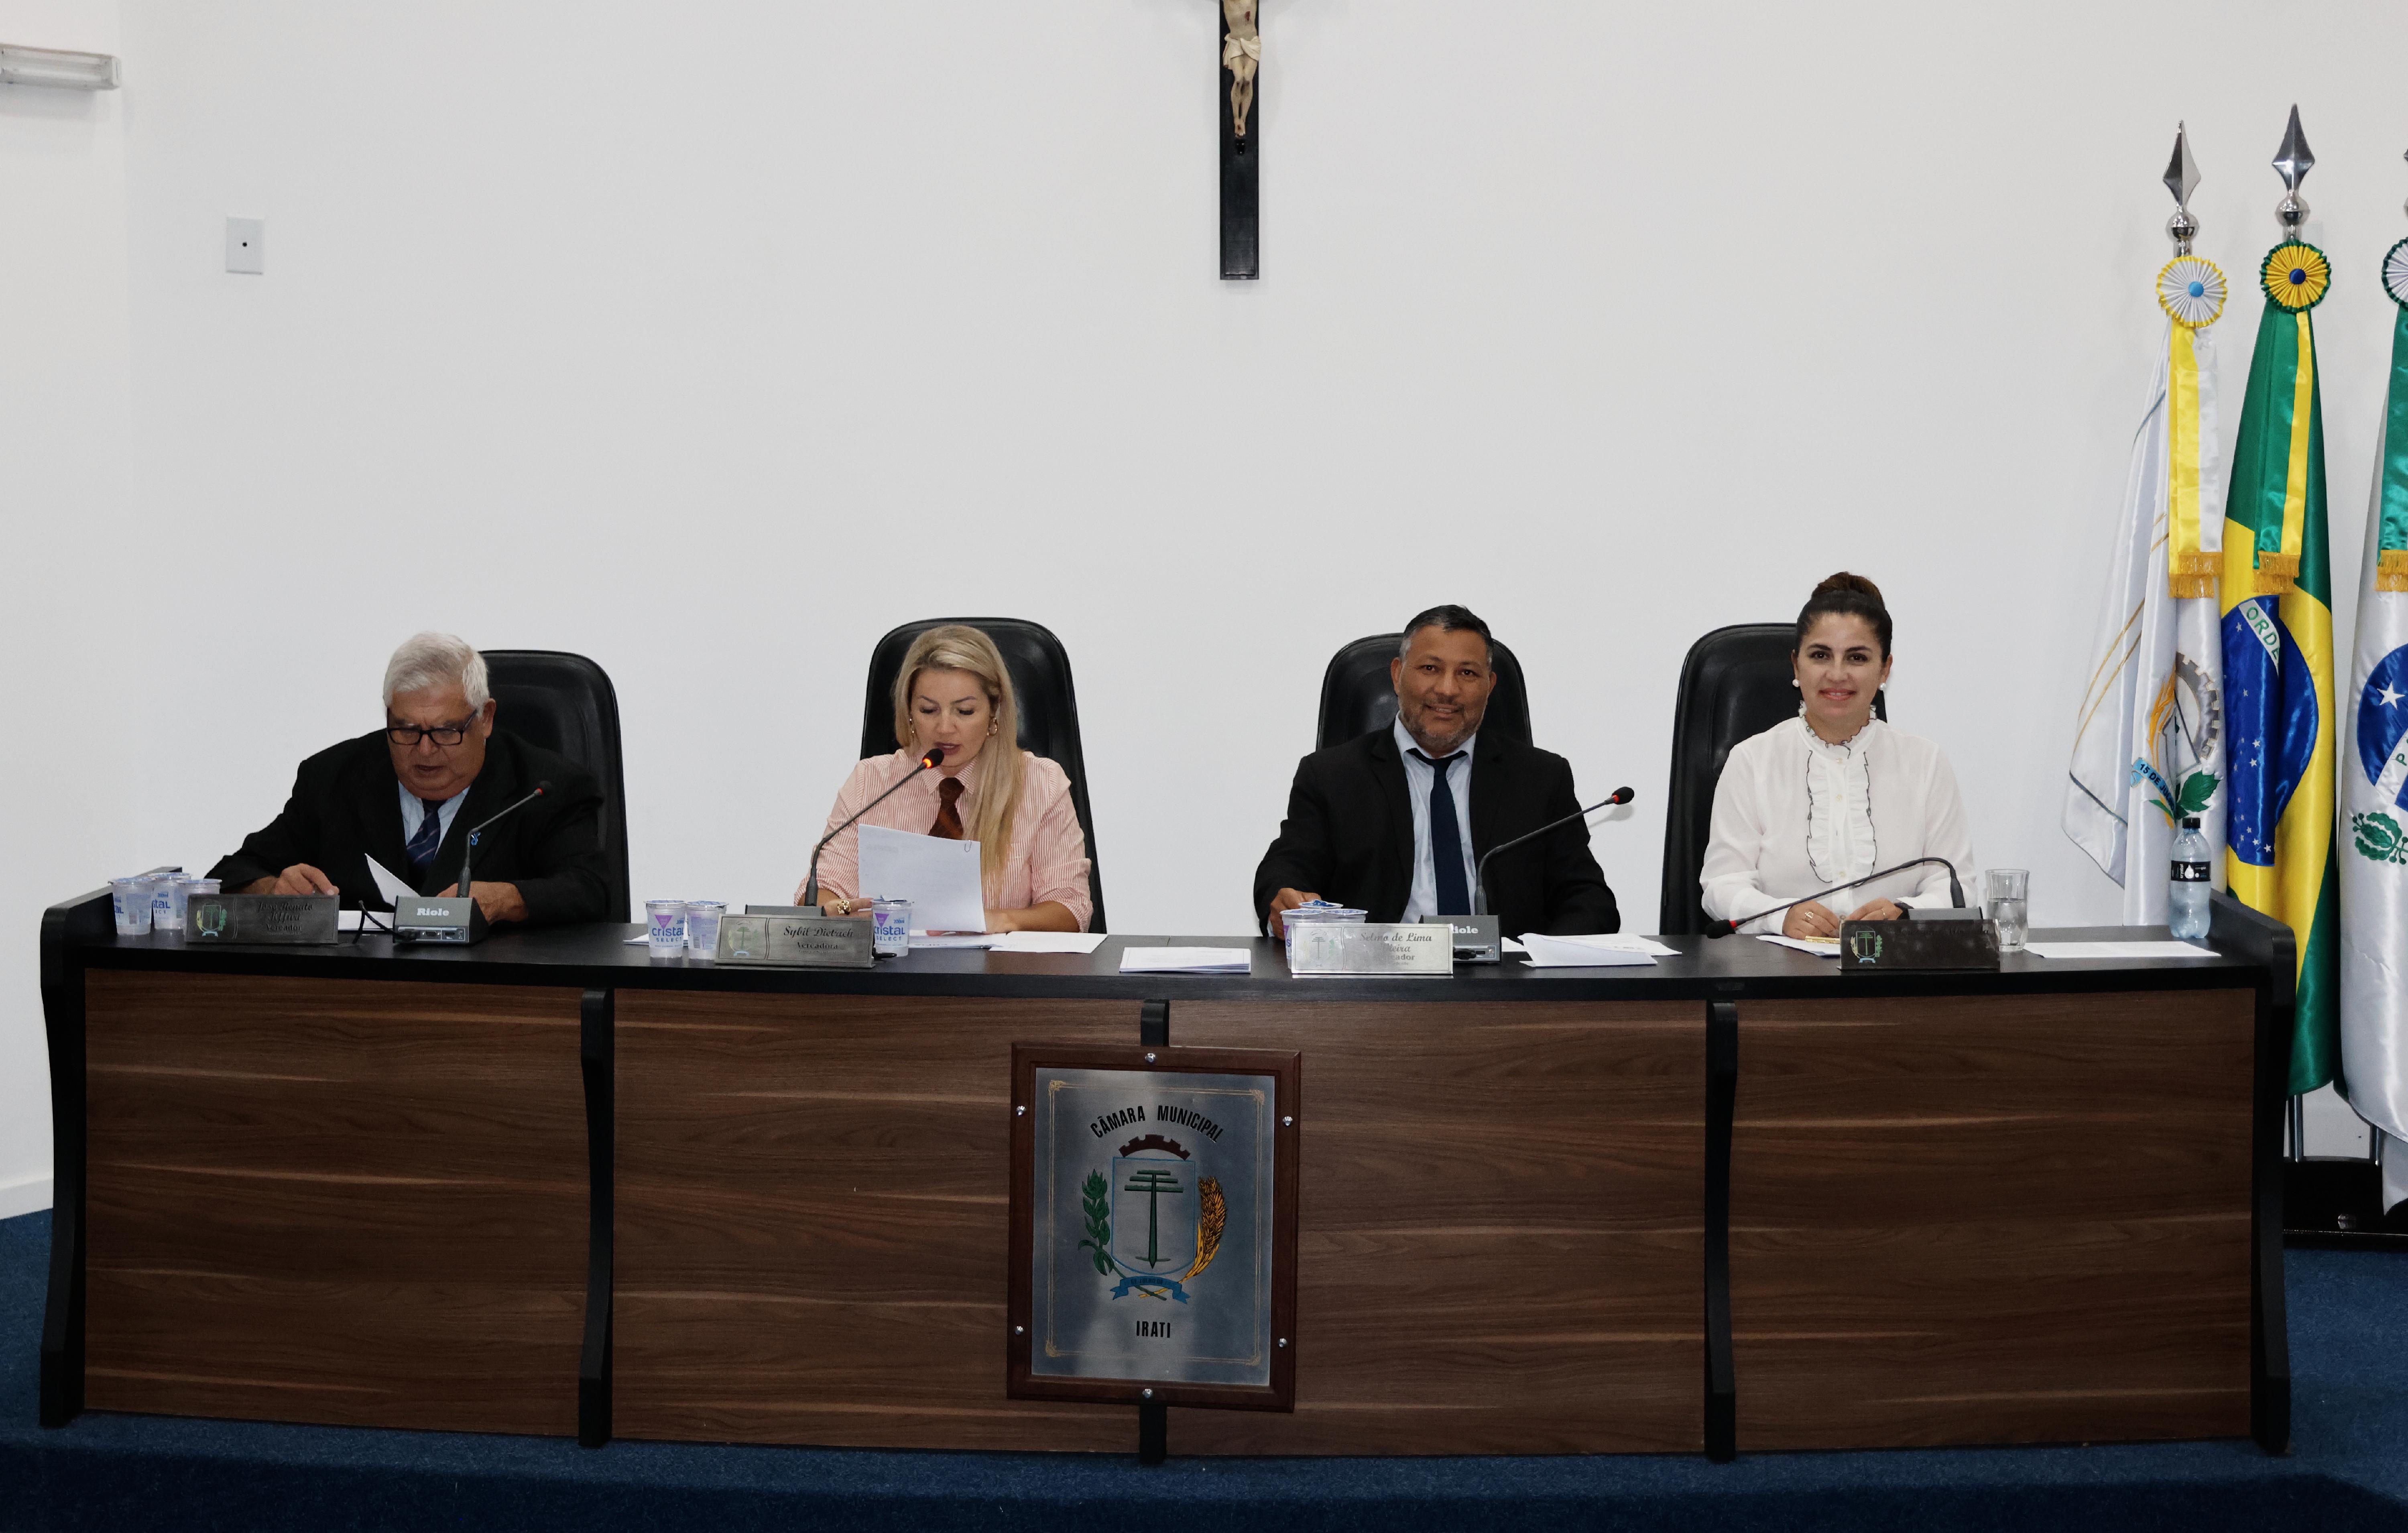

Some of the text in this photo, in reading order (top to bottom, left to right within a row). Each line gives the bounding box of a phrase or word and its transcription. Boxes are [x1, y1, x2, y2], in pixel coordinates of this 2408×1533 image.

[2246, 606, 2280, 660] ORDE
[2140, 764, 2150, 774] 15
[2149, 772, 2161, 785] DE
[417, 908, 449, 916] Riole
[783, 926, 809, 938] Sybil
[1361, 932, 1432, 941] Selmo de Lima
[1453, 925, 1479, 934] iole
[1090, 1105, 1223, 1143] CÂMARA MUNICIPAL
[1136, 1320, 1171, 1338] IRATI
